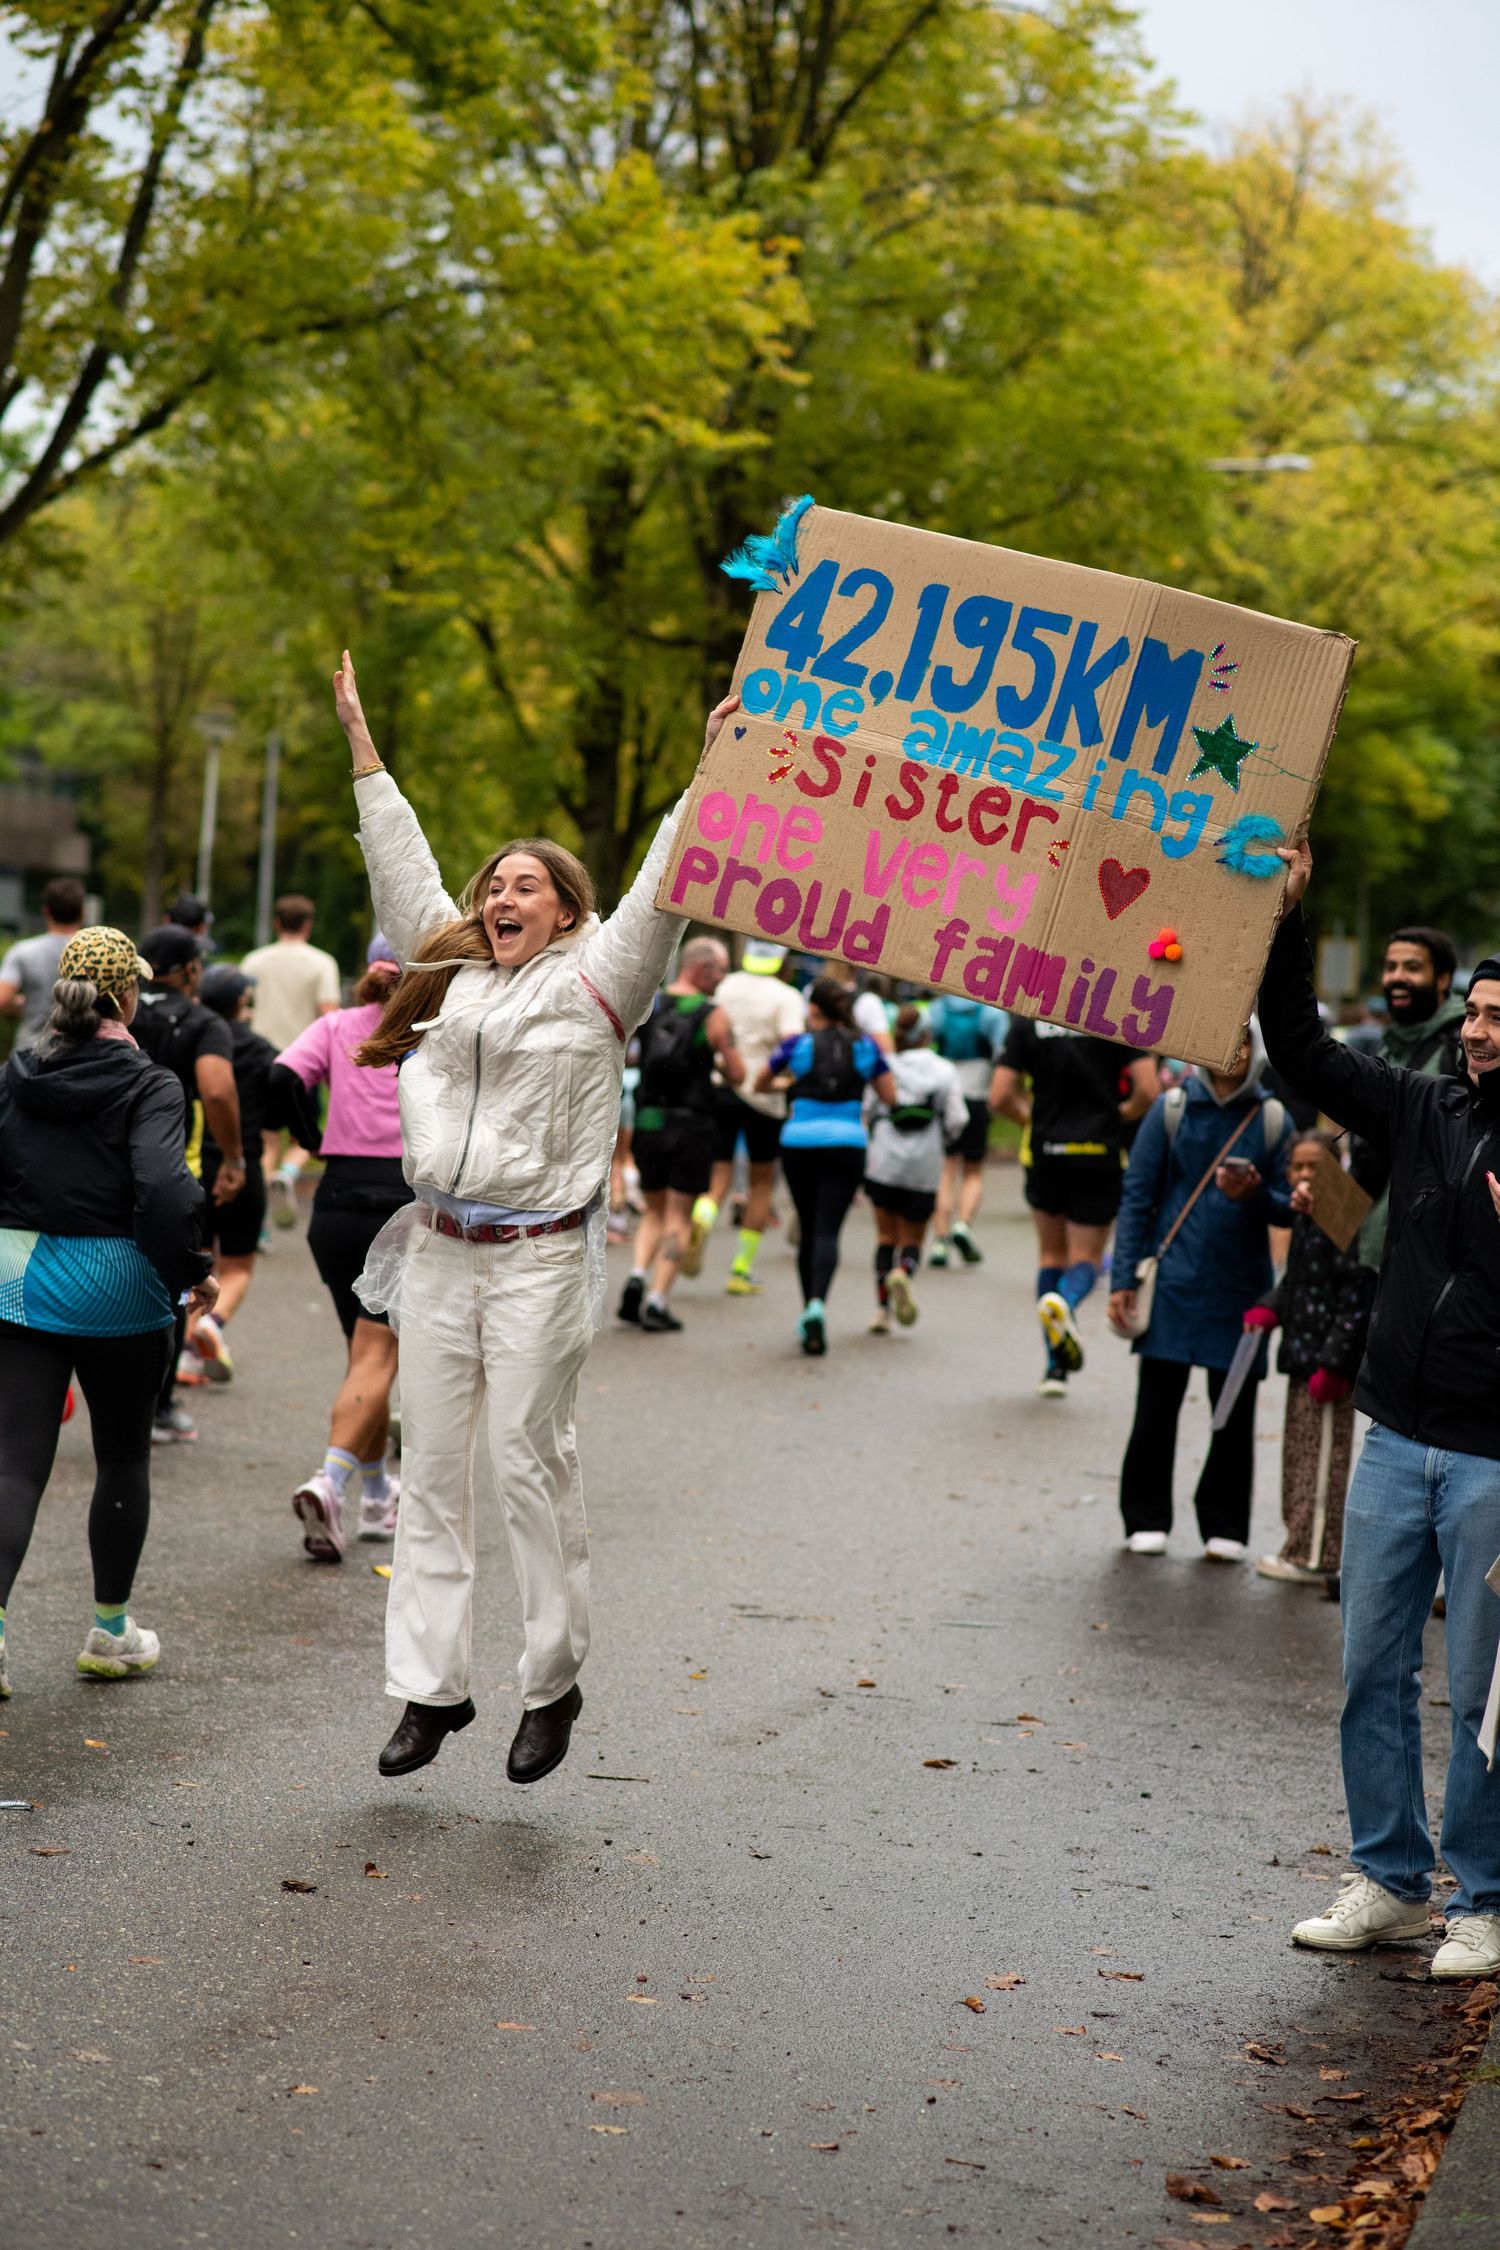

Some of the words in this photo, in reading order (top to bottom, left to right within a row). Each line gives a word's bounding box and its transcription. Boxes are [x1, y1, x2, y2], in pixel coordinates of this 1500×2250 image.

[741, 668, 865, 738] one
[901, 708, 1214, 859] amazing
[697, 790, 824, 873] one
[863, 829, 1039, 934] very
